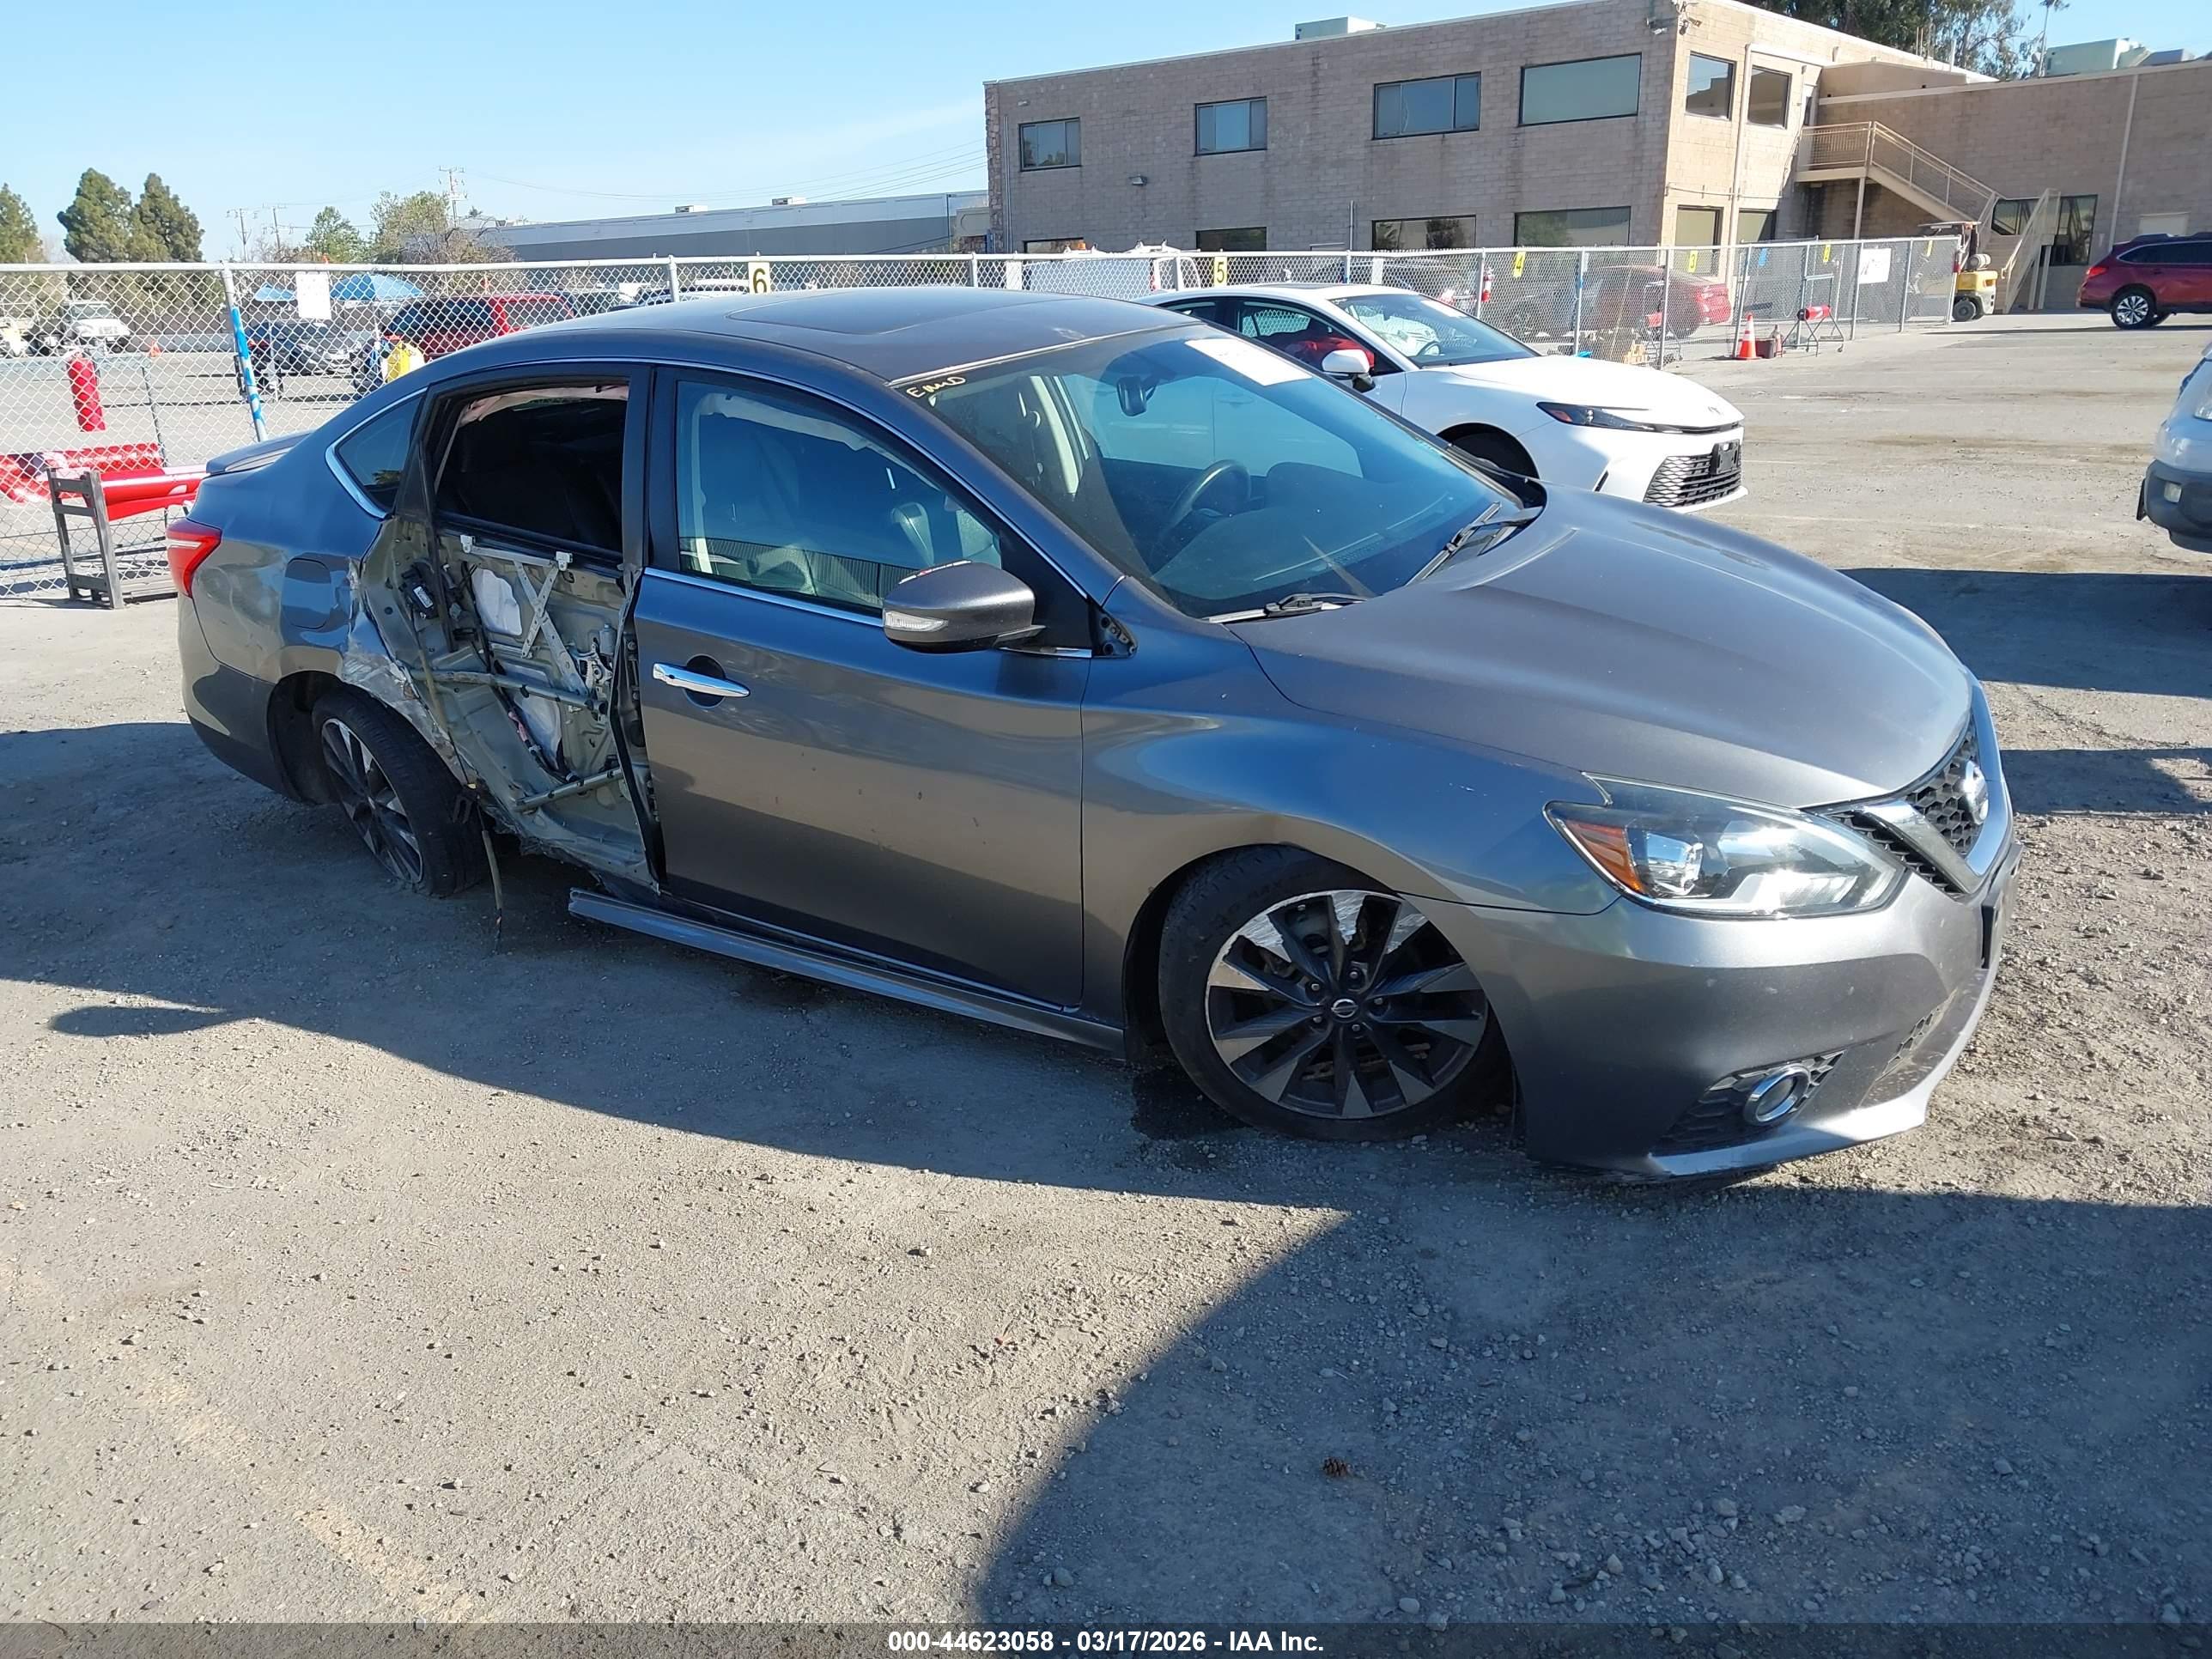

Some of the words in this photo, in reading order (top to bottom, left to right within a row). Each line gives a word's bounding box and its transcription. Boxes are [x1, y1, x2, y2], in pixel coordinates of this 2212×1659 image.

[1516, 255, 1523, 272] 4
[1690, 253, 1695, 269] 3
[753, 268, 767, 294] 6
[1217, 261, 1224, 283] 5
